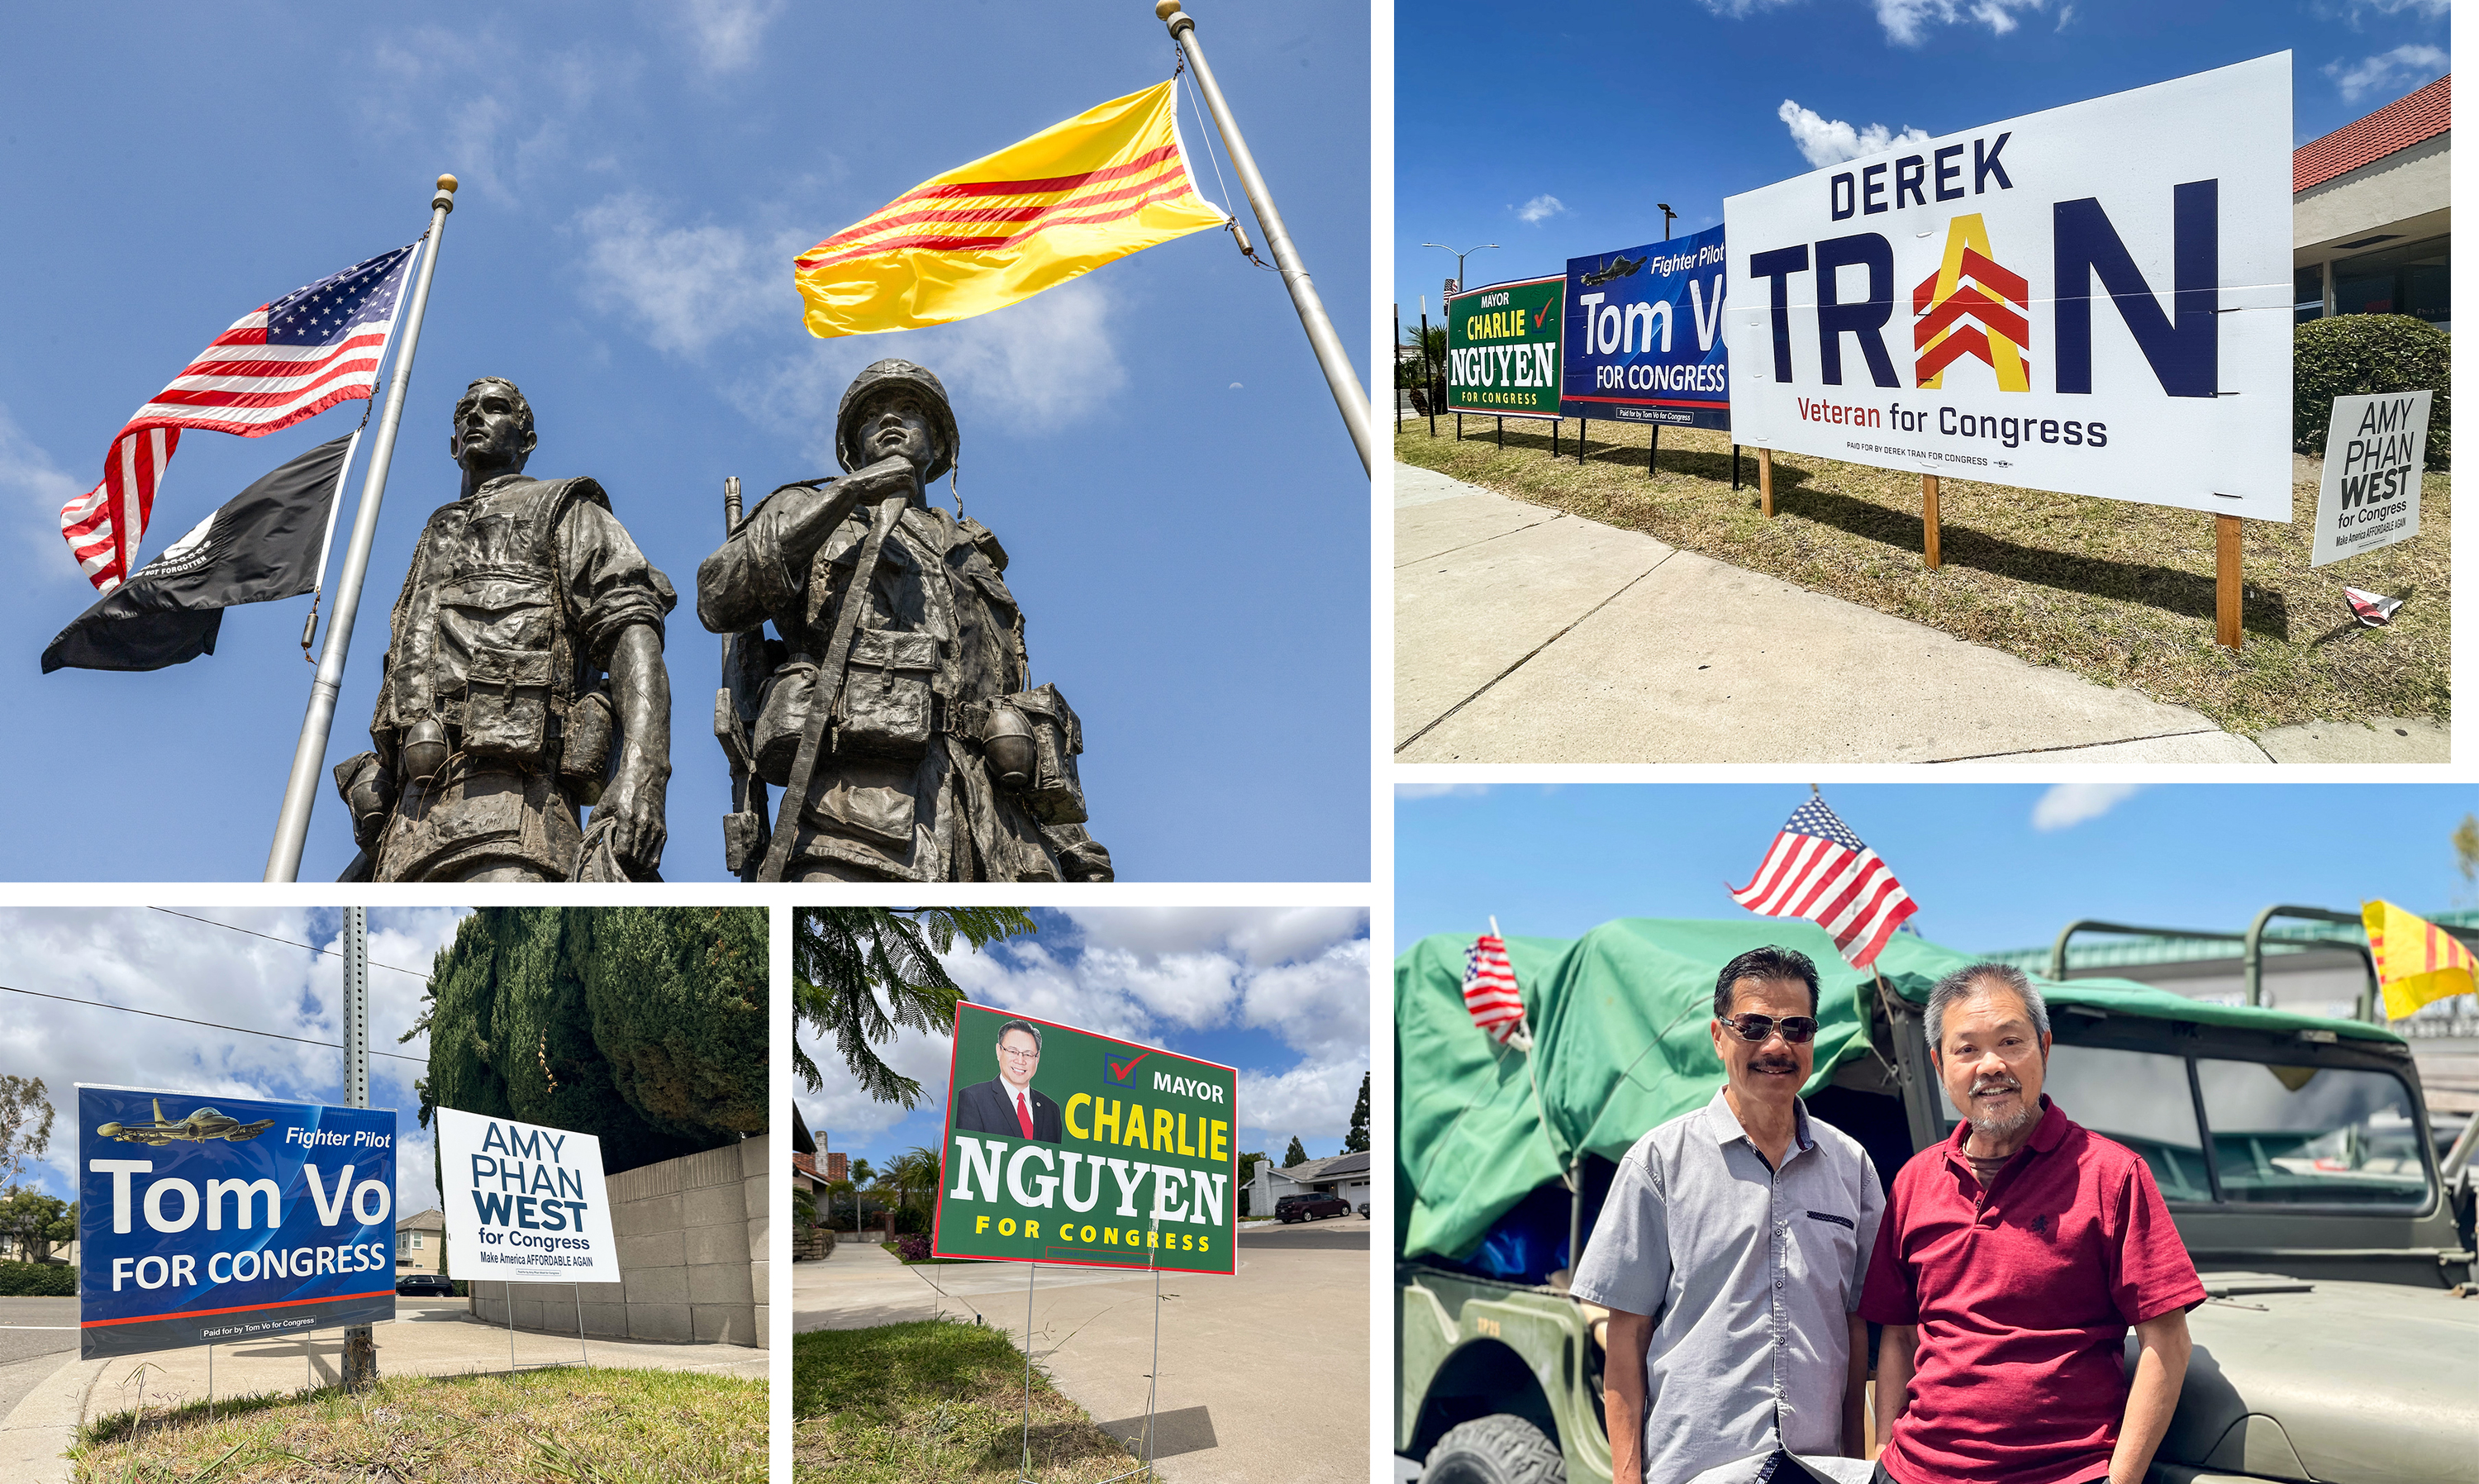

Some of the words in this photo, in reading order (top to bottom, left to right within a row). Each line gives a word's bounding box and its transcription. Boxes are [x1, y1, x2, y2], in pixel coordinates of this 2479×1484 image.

[1830, 131, 2014, 221] DEREK
[1651, 252, 1698, 277] Fighter
[1699, 242, 1725, 268] Pilot
[1481, 292, 1510, 309] MAYOR
[1749, 178, 2219, 398] TRAN
[1467, 309, 1525, 340] CHARLIE
[1580, 292, 1672, 355] Tom
[1689, 273, 1729, 352] V
[1450, 342, 1556, 388] NGUYEN
[1596, 364, 1624, 389] FOR
[1628, 364, 1725, 392] CONGRESS
[1462, 391, 1479, 402] FOR
[1482, 392, 1537, 406] CONGRESS
[1636, 411, 1641, 419] by
[1668, 412, 1691, 422] Congress
[2358, 397, 2415, 437] AMY
[1797, 397, 1881, 429] Veteran
[1889, 402, 1928, 433] for
[1939, 406, 2107, 448] Congress
[1847, 441, 1860, 450] PAID
[1862, 443, 1873, 452] FOR
[1884, 446, 1906, 456] DEREK
[1907, 449, 1926, 459] TRAN
[1929, 452, 1943, 461] FOR
[1944, 454, 1988, 466] CONGRESS
[2343, 431, 2415, 475] PHAN
[2340, 466, 2411, 511] WEST
[2336, 535, 2348, 547] Make
[2348, 530, 2366, 544] America
[2366, 521, 2394, 538] AFFORDABLE
[2339, 513, 2355, 529] for
[2358, 501, 2407, 521] Congress
[161, 555, 207, 575] FORGOTTEN
[1153, 1071, 1224, 1104] MAYOR
[286, 1126, 350, 1149] Fighter
[354, 1130, 391, 1148] Pilot
[482, 1121, 565, 1163] AMY
[1064, 1092, 1228, 1162] CHARLIE
[89, 1158, 281, 1234] Tom
[303, 1163, 391, 1227] Vo
[471, 1153, 583, 1201] PHAN
[949, 1135, 1227, 1226] NGUYEN
[471, 1190, 588, 1233] WEST
[478, 1227, 503, 1244] for
[509, 1231, 590, 1253] Congress
[975, 1215, 1040, 1239] FOR
[1059, 1223, 1210, 1253] CONGRESS
[112, 1254, 197, 1292] FOR
[207, 1243, 386, 1284] CONGRESS
[480, 1251, 498, 1263] Make
[500, 1253, 526, 1265] America
[526, 1254, 572, 1266] AFFORDABLE
[573, 1256, 593, 1267] AGAIN
[203, 1329, 220, 1337] Paid
[234, 1326, 243, 1334] by
[283, 1318, 315, 1327] Congress
